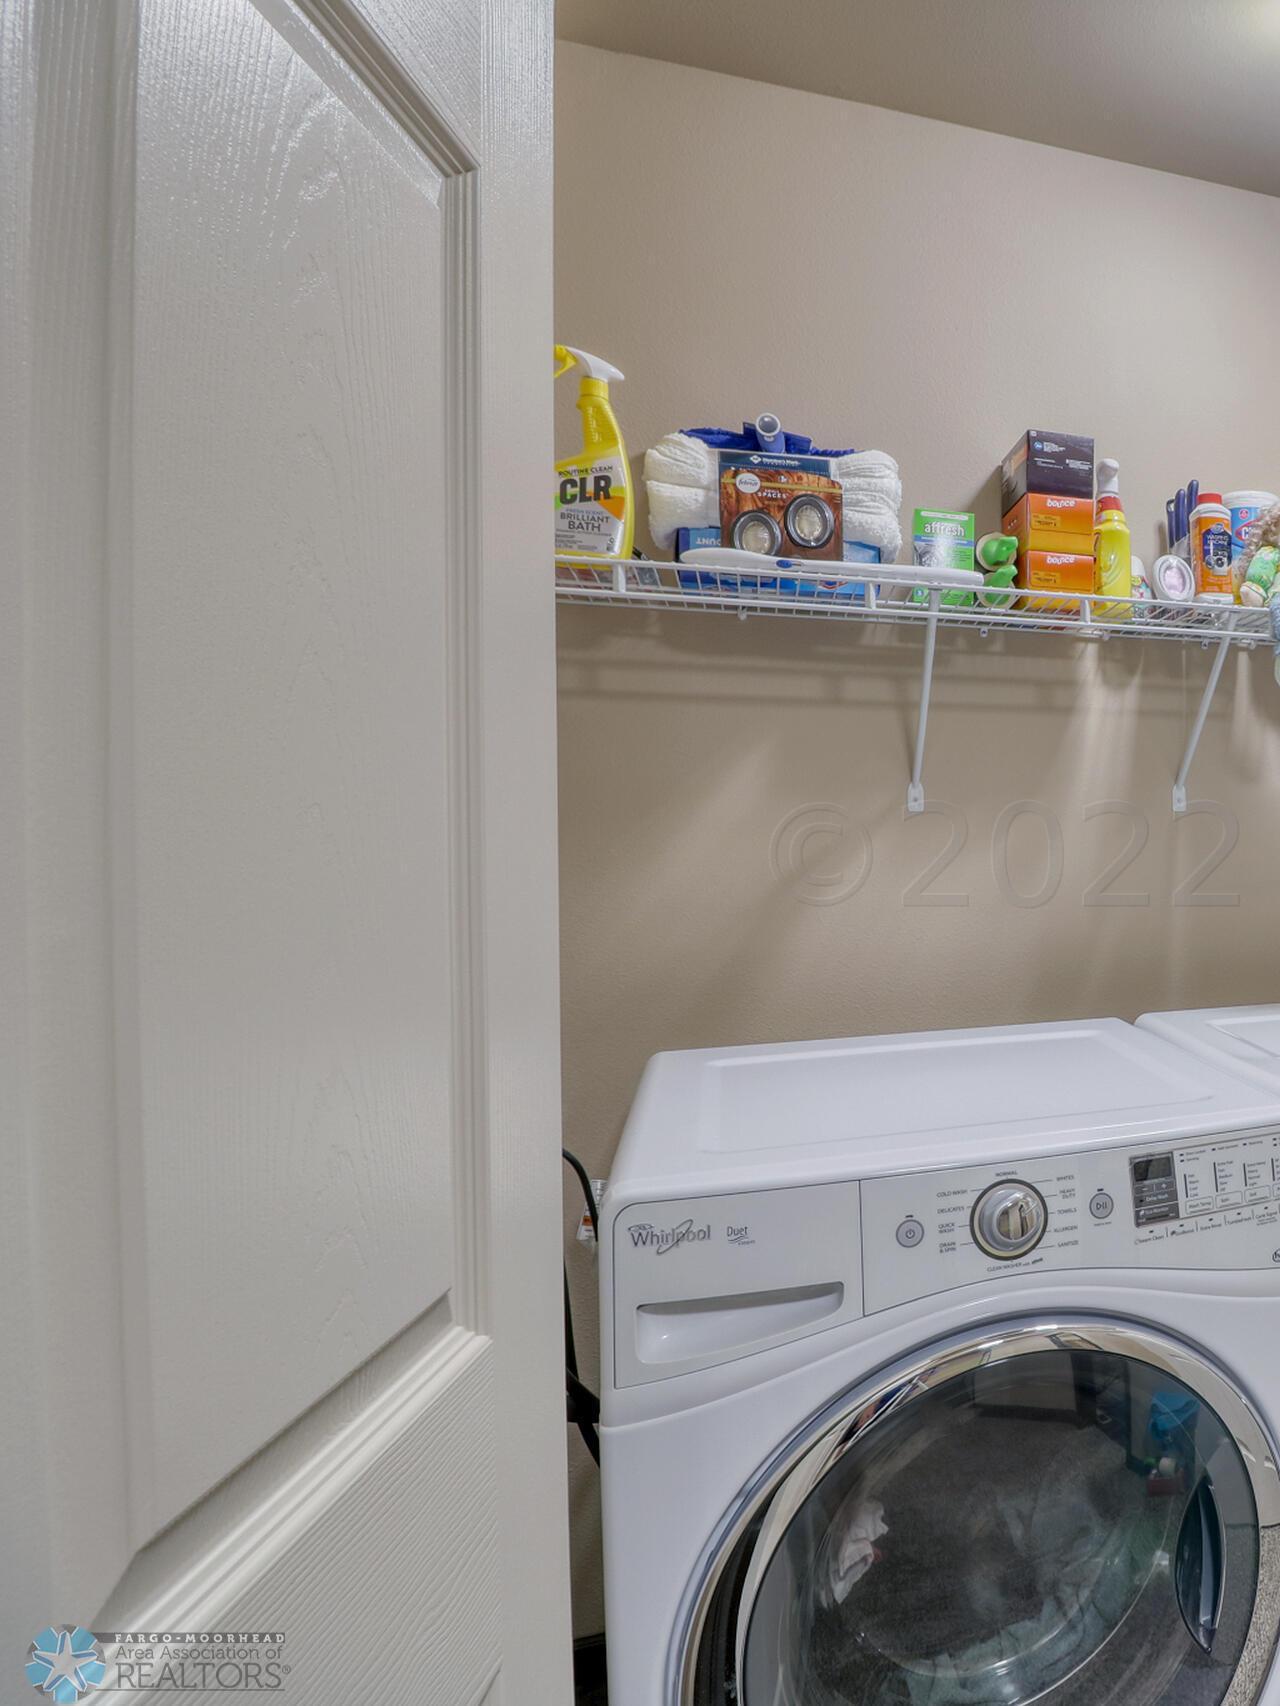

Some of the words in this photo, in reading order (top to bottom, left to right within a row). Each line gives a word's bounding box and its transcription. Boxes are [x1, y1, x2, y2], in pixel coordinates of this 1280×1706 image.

[559, 475, 612, 505] CLR
[1046, 499, 1076, 508] bounce
[560, 512, 610, 524] BRILLIANT
[568, 521, 601, 532] BATH
[924, 521, 965, 537] affresh
[1046, 555, 1076, 564] bounce
[629, 1224, 711, 1248] Whirlpool
[726, 1226, 748, 1237] Duet
